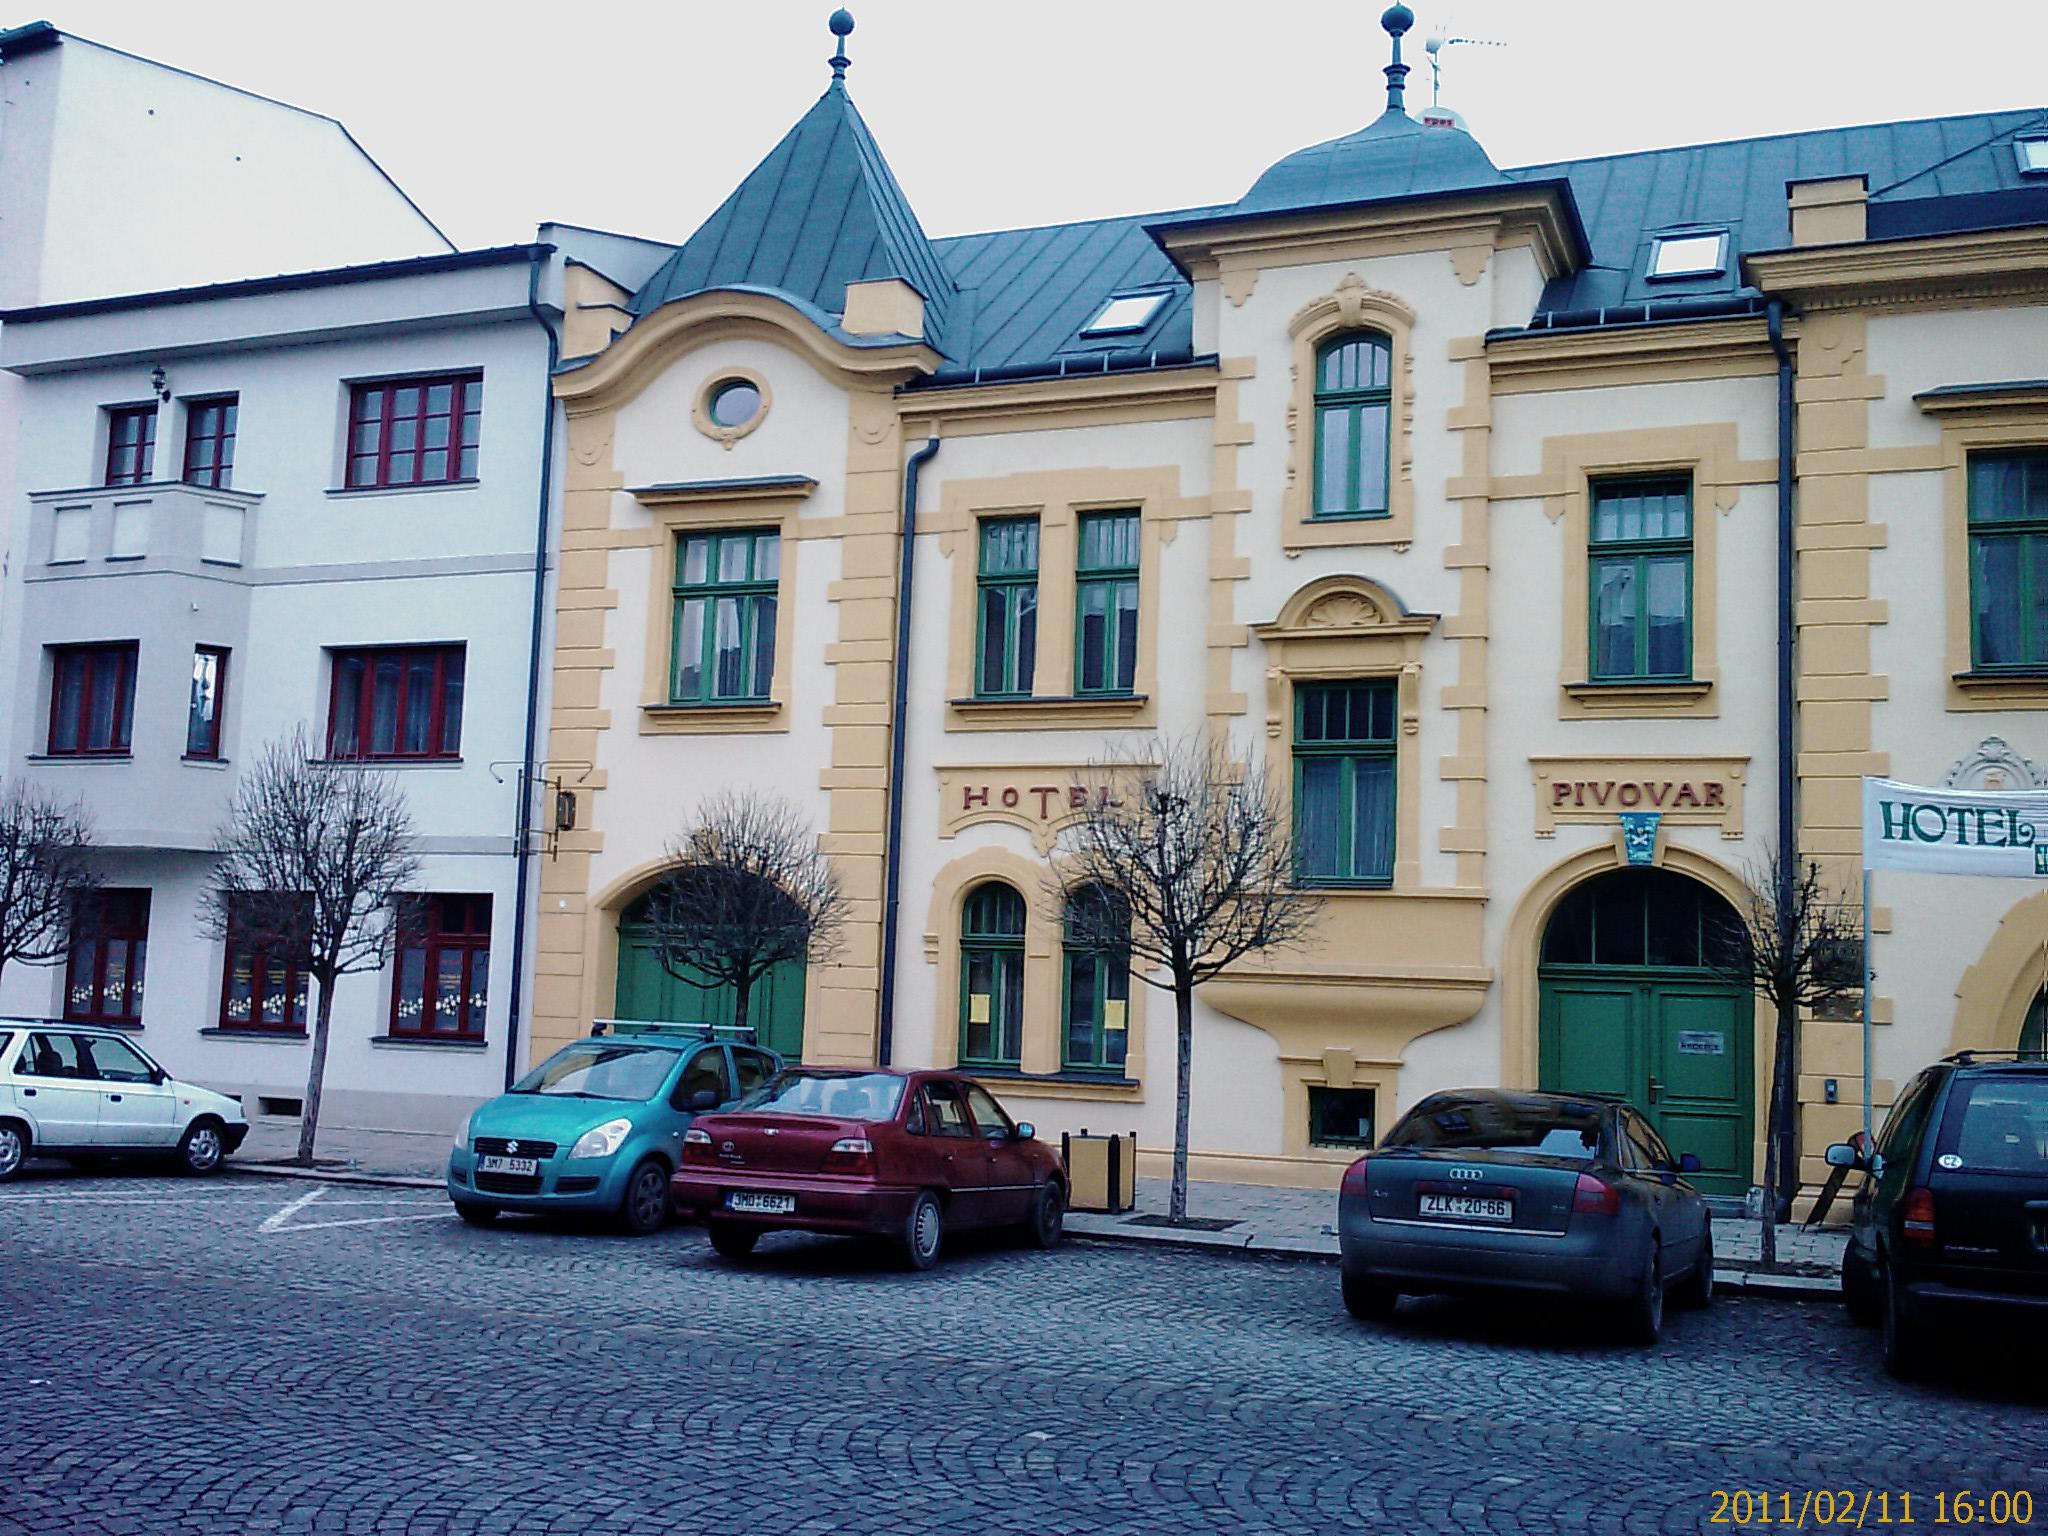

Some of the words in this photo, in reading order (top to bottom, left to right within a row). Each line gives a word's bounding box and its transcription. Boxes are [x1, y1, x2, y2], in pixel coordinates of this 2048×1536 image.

[963, 785, 1125, 819] HOTEL
[1552, 782, 1725, 807] PIVOVAR
[1879, 800, 2036, 848] HOTEL
[1944, 1155, 1957, 1167] CZ
[762, 1195, 791, 1209] 6621
[1426, 1196, 1457, 1212] ZLK
[1463, 1199, 1506, 1216] 20-66
